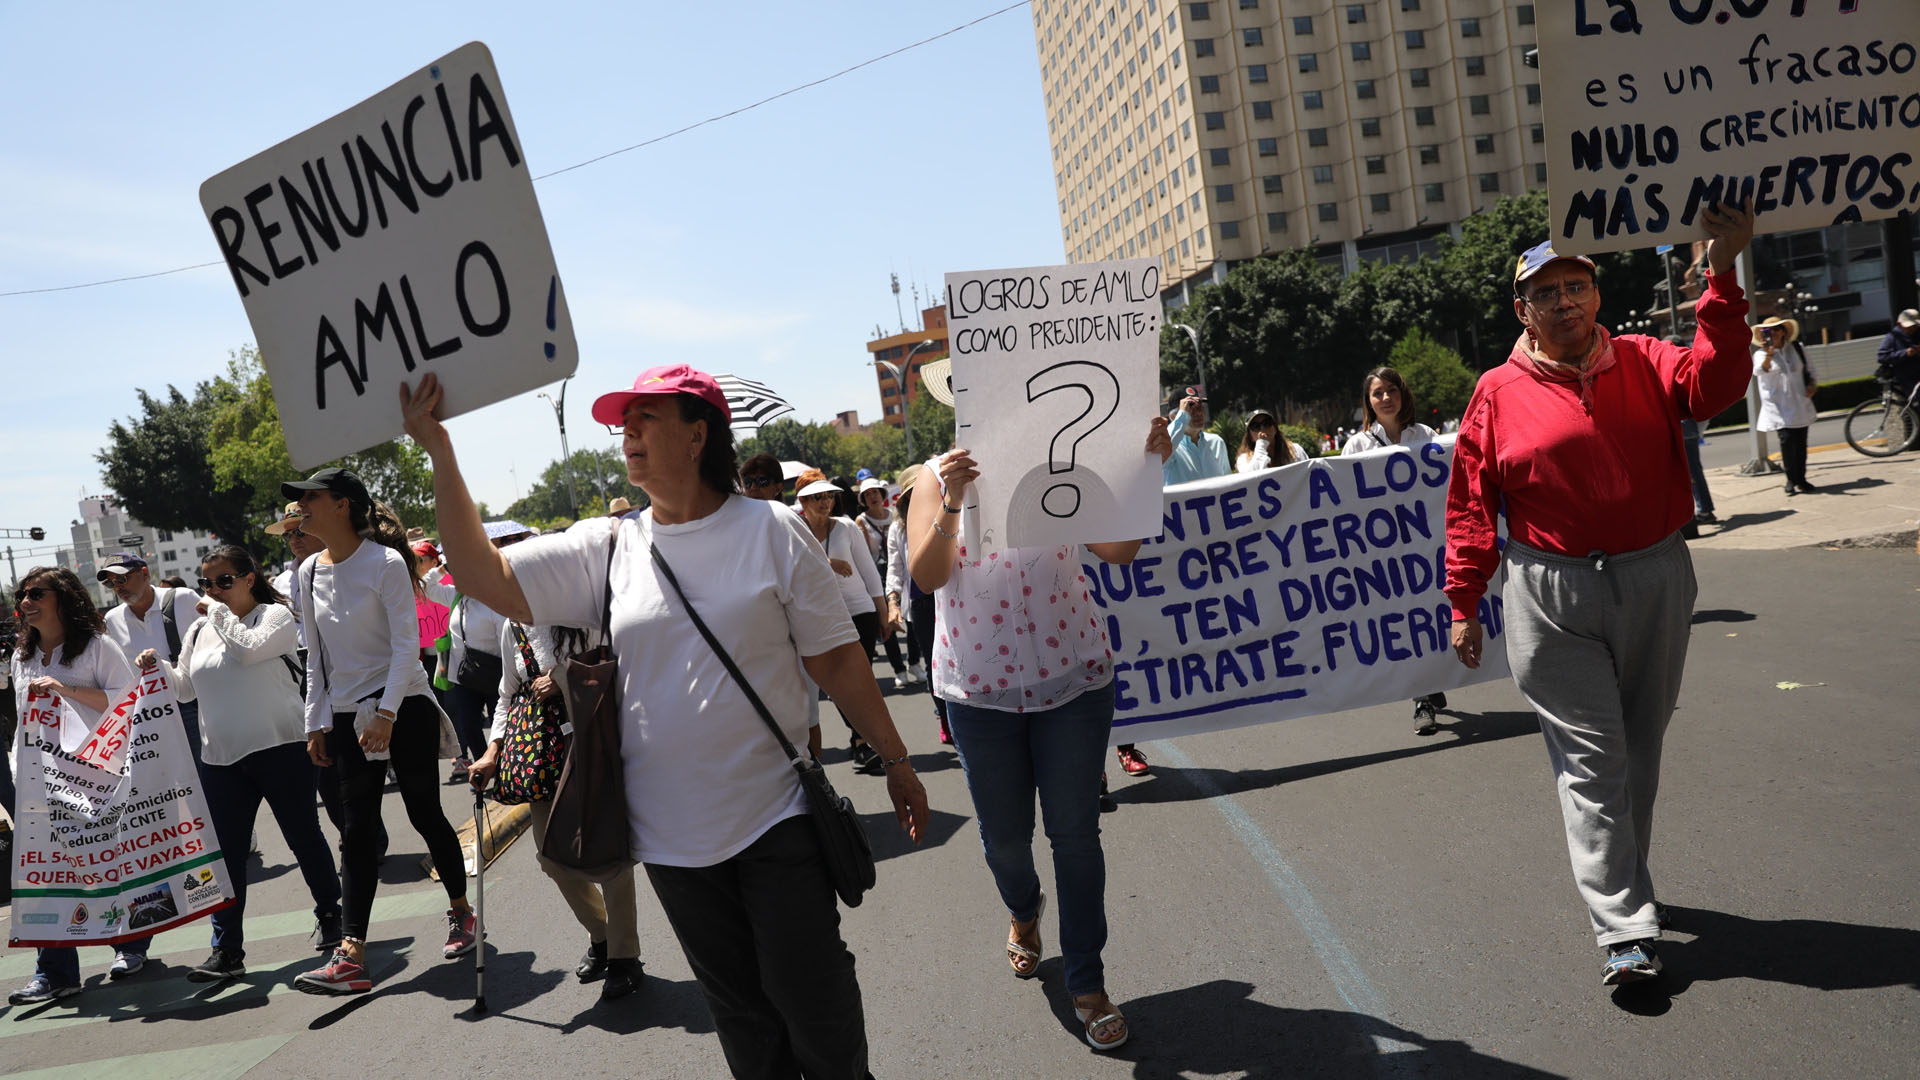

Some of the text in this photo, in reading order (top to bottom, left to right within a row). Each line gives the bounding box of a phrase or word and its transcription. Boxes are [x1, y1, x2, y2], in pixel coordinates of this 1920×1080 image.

[1586, 33, 1916, 107] es un fracaso
[1571, 123, 1680, 172] NULO
[1563, 173, 1669, 240] MÁS
[948, 266, 1158, 320] LOGROS DE AMLO
[956, 312, 1156, 354] COMO PRESIDENTE:
[1026, 361, 1121, 518] ?
[1309, 442, 1450, 509] A LOS
[1143, 479, 1281, 544] NTES
[1178, 500, 1432, 591] CREYERON
[1162, 588, 1260, 645] TEN
[1279, 542, 1446, 622] DIGNID
[1113, 631, 1321, 712] ETIRATE.
[132, 703, 174, 726] atos
[130, 808, 166, 828] CNTE
[89, 850, 115, 865] LO
[135, 838, 204, 871] VAYAS!
